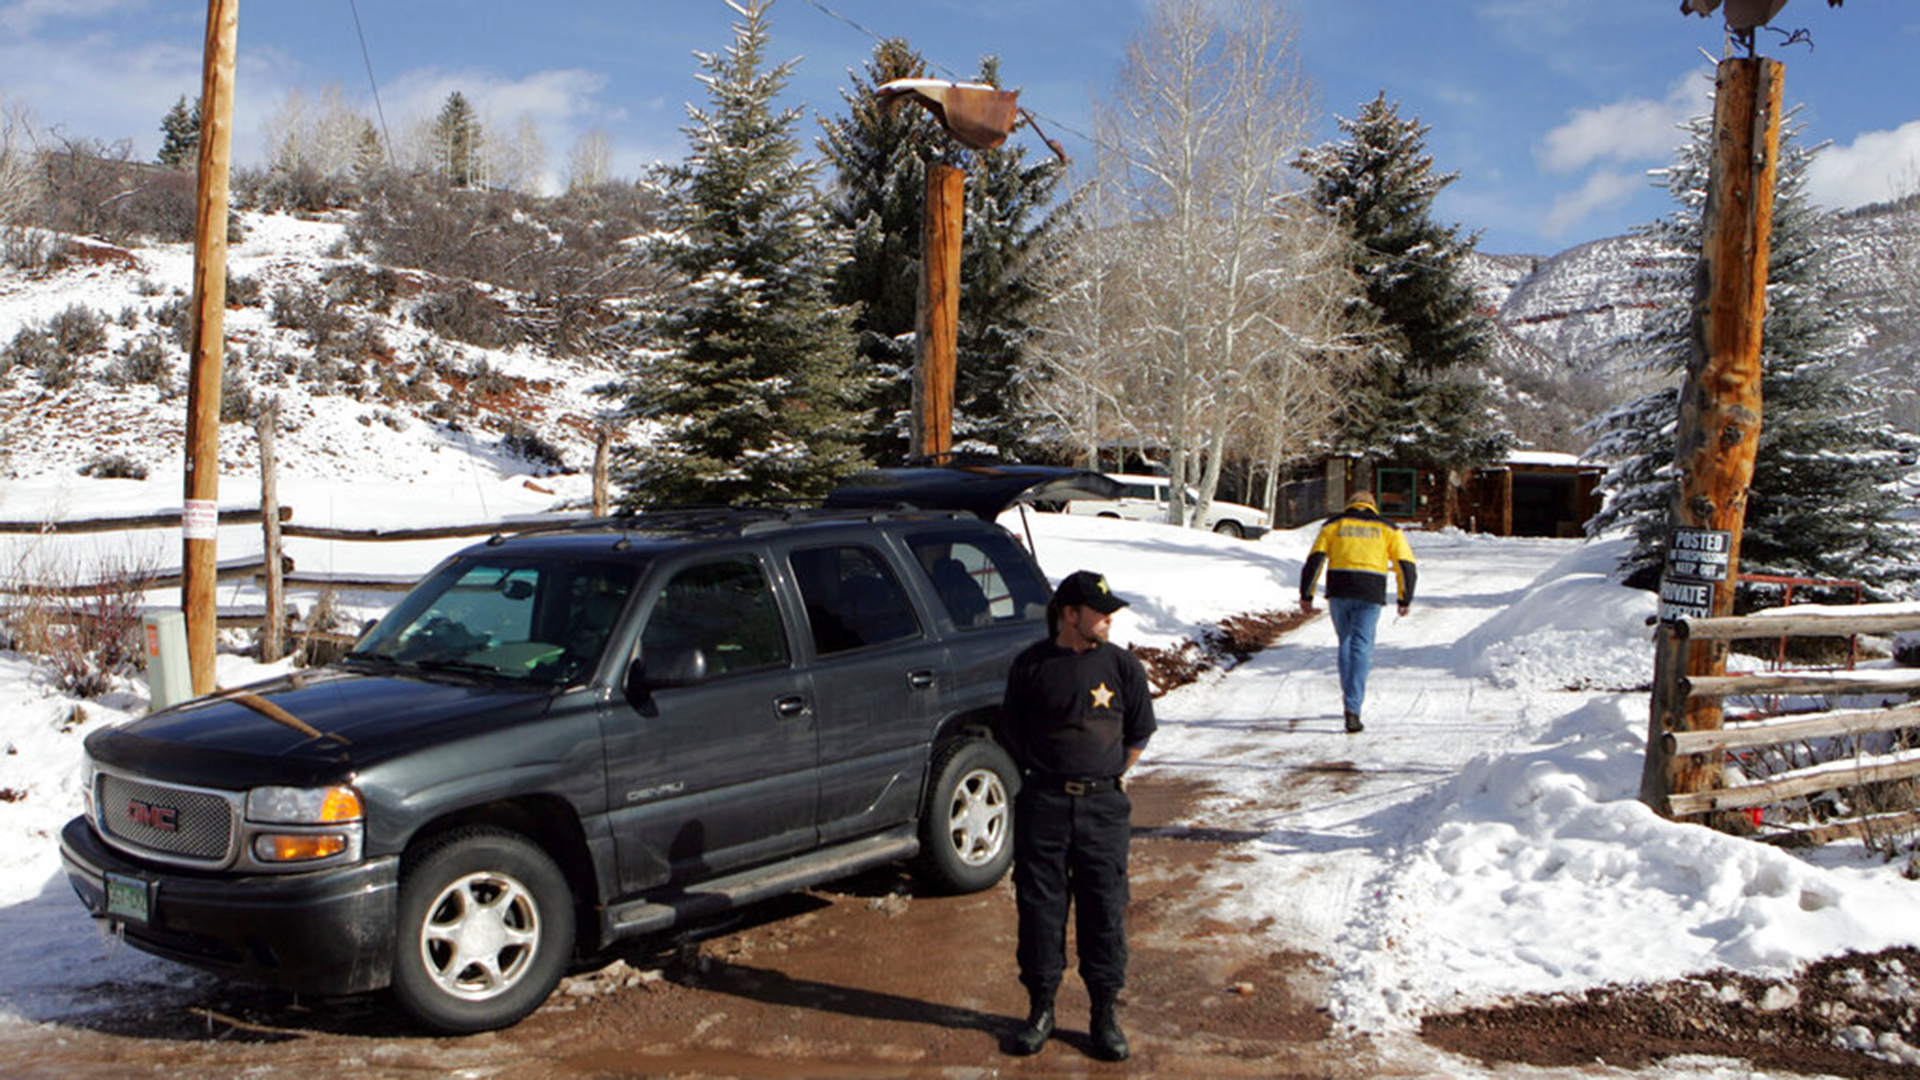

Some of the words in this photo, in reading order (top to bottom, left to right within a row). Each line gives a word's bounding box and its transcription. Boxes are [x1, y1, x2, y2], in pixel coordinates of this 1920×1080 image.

[1676, 532, 1724, 551] POSTED
[1699, 564, 1717, 577] OUT
[126, 801, 175, 831] GMC
